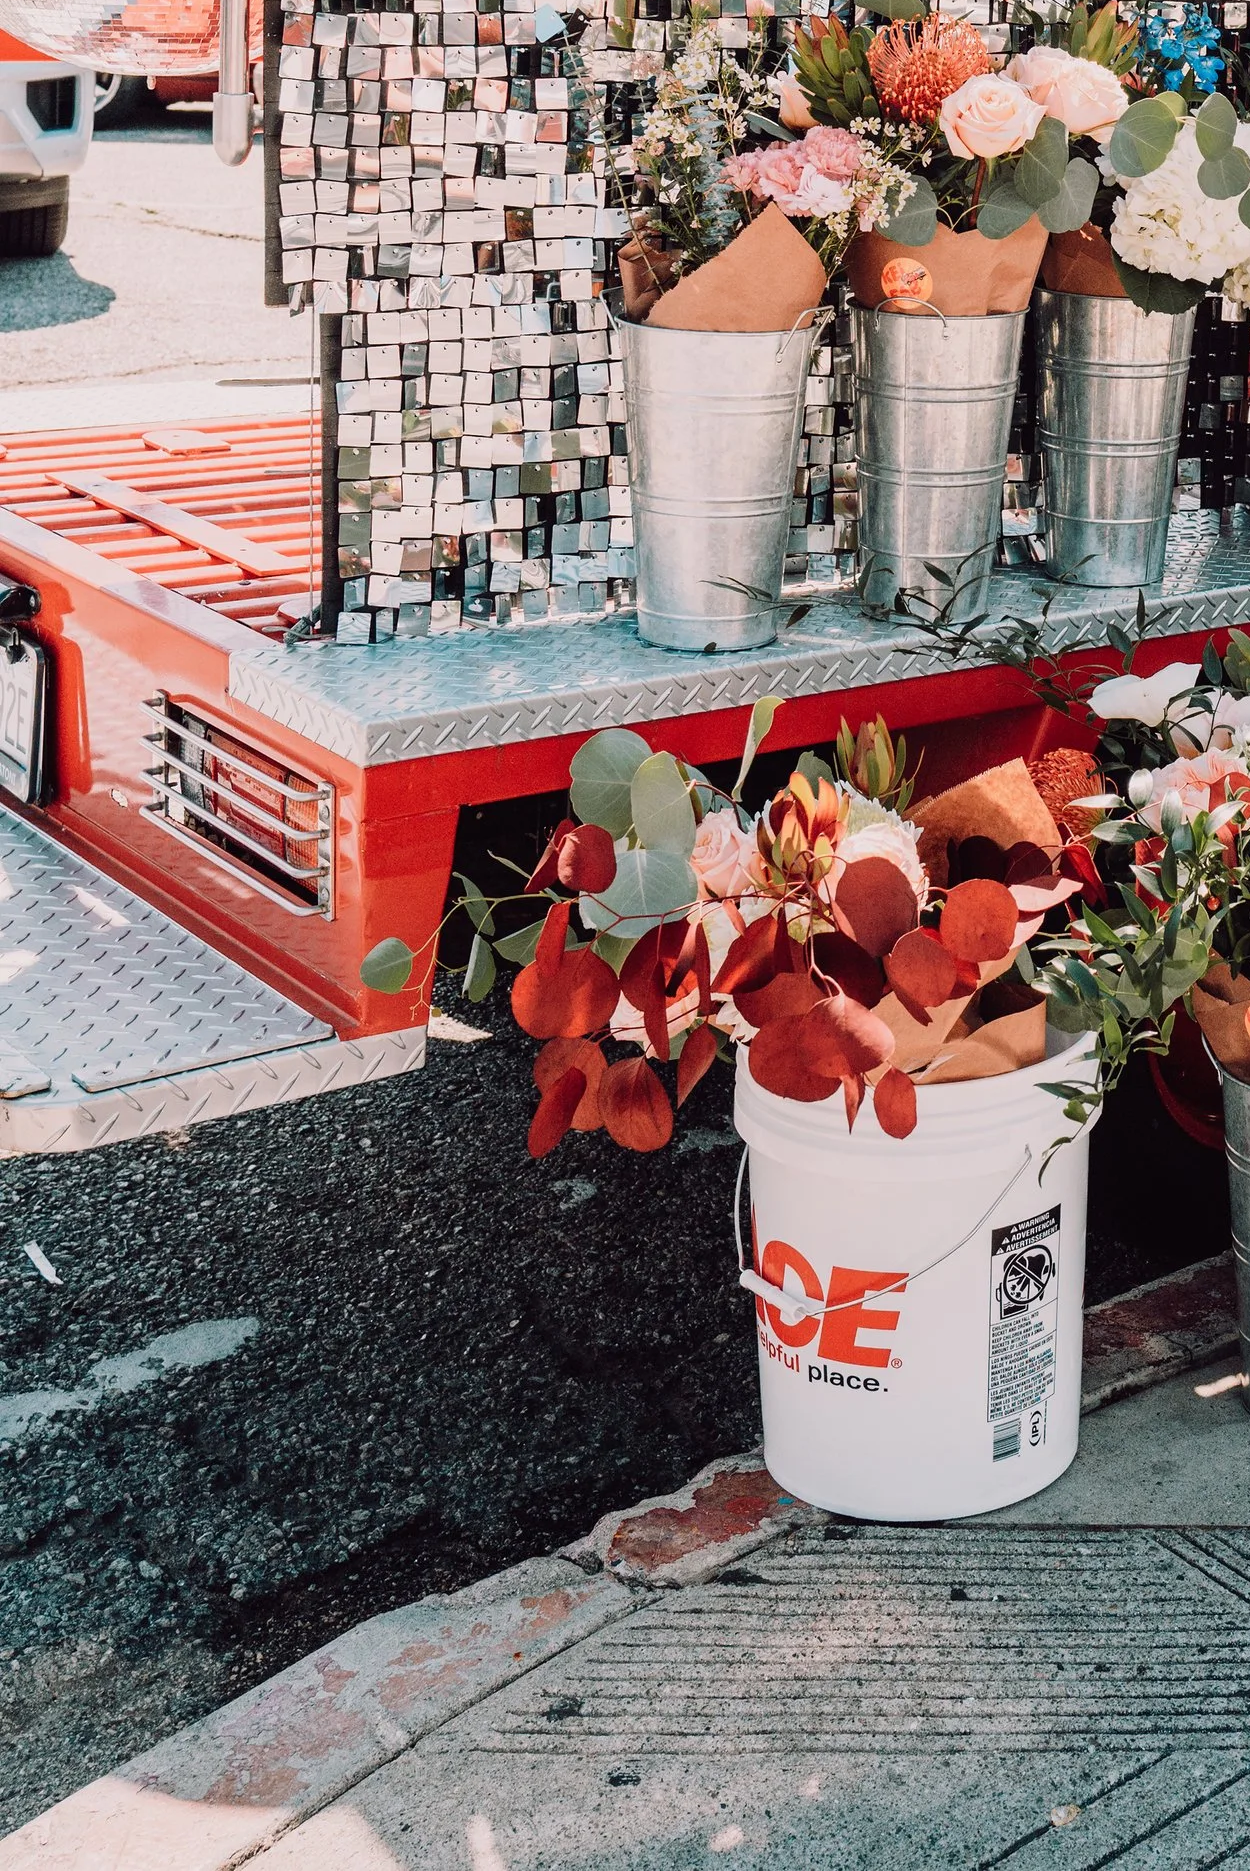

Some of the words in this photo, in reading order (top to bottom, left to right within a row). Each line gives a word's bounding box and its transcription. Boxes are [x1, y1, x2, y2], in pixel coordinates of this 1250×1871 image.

[0, 675, 28, 755] 2E
[1011, 1218, 1055, 1242] ADVERTENCIA
[1018, 1212, 1050, 1231] WARNING
[1006, 1224, 1058, 1252] AVERTISSEMENT
[992, 1323, 1012, 1332] CHILDREN
[992, 1329, 1007, 1337] BUCKET
[1018, 1321, 1031, 1329] DROWN
[1003, 1331, 1022, 1340] CHILDREN
[992, 1341, 1009, 1349] BUCKETS
[992, 1346, 1009, 1355] AMOUNT
[808, 1364, 889, 1392] place.
